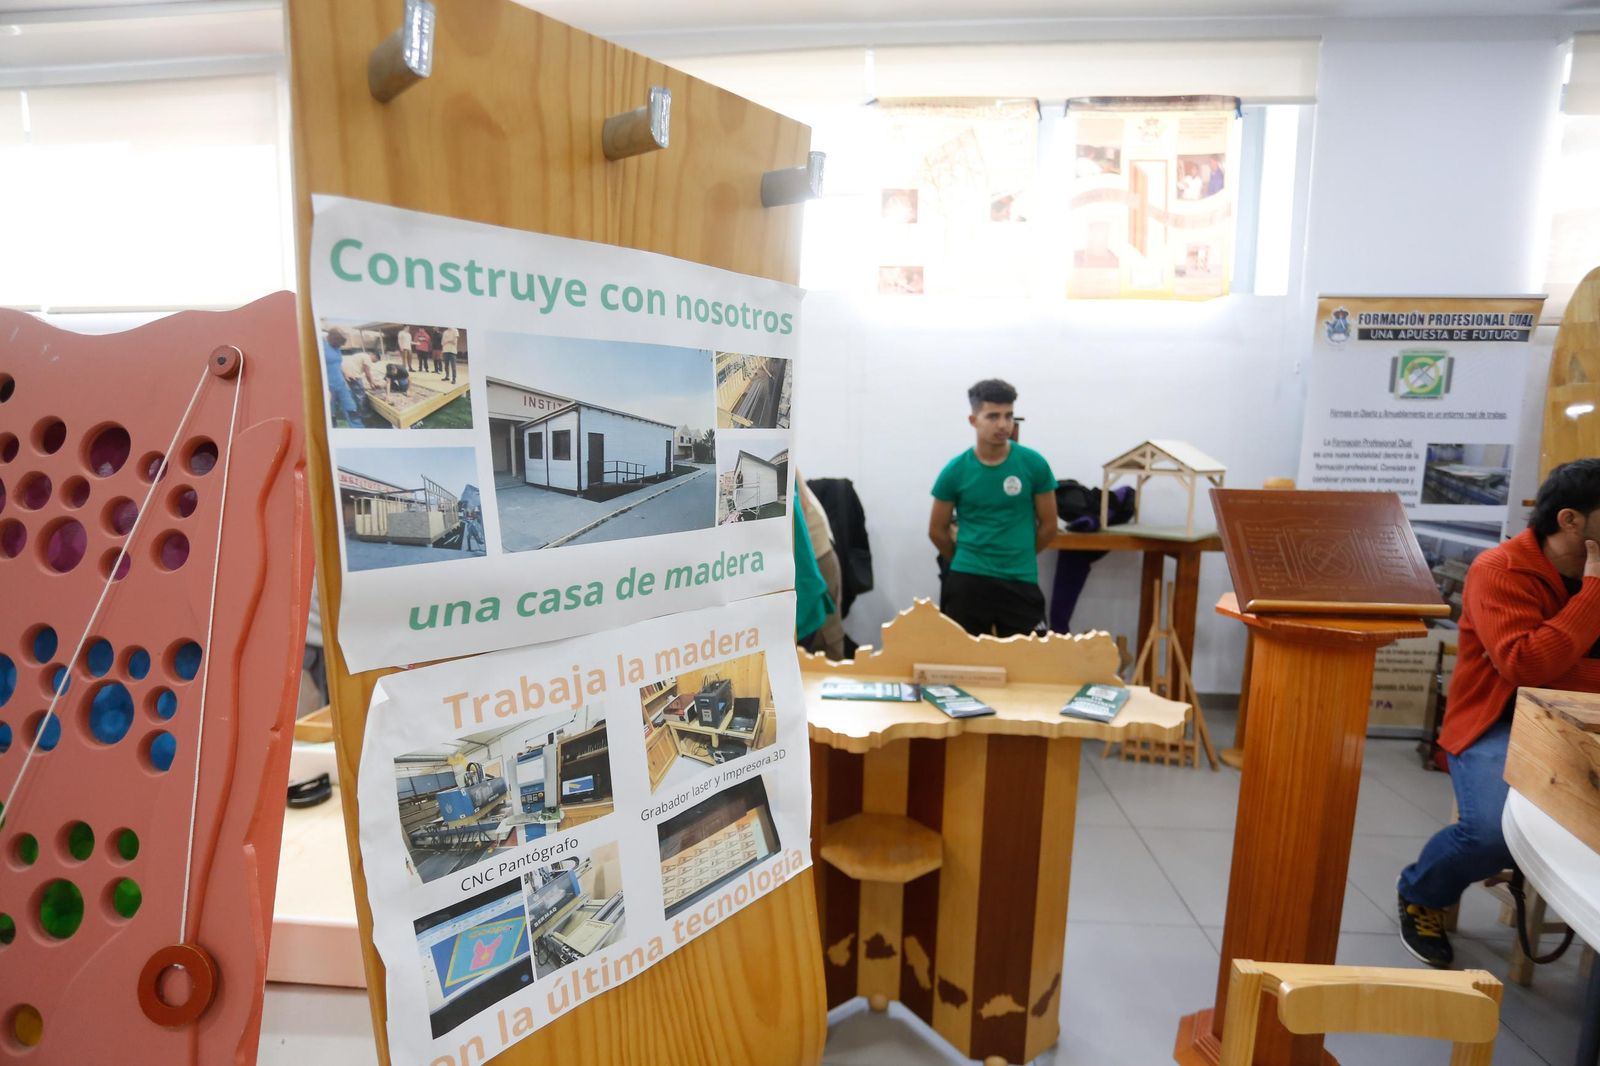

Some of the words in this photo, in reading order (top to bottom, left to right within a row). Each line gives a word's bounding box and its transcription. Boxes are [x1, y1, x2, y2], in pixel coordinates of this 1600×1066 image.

[330, 238, 587, 314] Construye
[600, 283, 666, 315] con
[676, 292, 793, 335] nosotros
[1358, 310, 1424, 327] FORMACIÓN
[1428, 313, 1505, 327] PROFESIONAL
[1509, 313, 1534, 327] DUAL
[1370, 329, 1393, 340] UNA
[1397, 329, 1449, 340] APUESTA
[1453, 330, 1467, 340] DE
[1472, 330, 1520, 341] FUTURO
[409, 595, 500, 631] una
[515, 581, 604, 618] casa
[615, 567, 656, 601] de
[664, 550, 764, 592] madera
[443, 666, 607, 729] Trabaja
[617, 654, 645, 688] la
[656, 625, 760, 673] madera
[641, 791, 690, 822] Grabador
[692, 778, 712, 797] laser
[714, 775, 721, 788] y
[723, 757, 771, 782] Impresora
[773, 749, 787, 762] 3D
[461, 867, 495, 892] CNC
[498, 836, 579, 878] Pantógrafo
[497, 1006, 534, 1045] la
[547, 936, 664, 1015] última
[672, 847, 805, 945] tecnología
